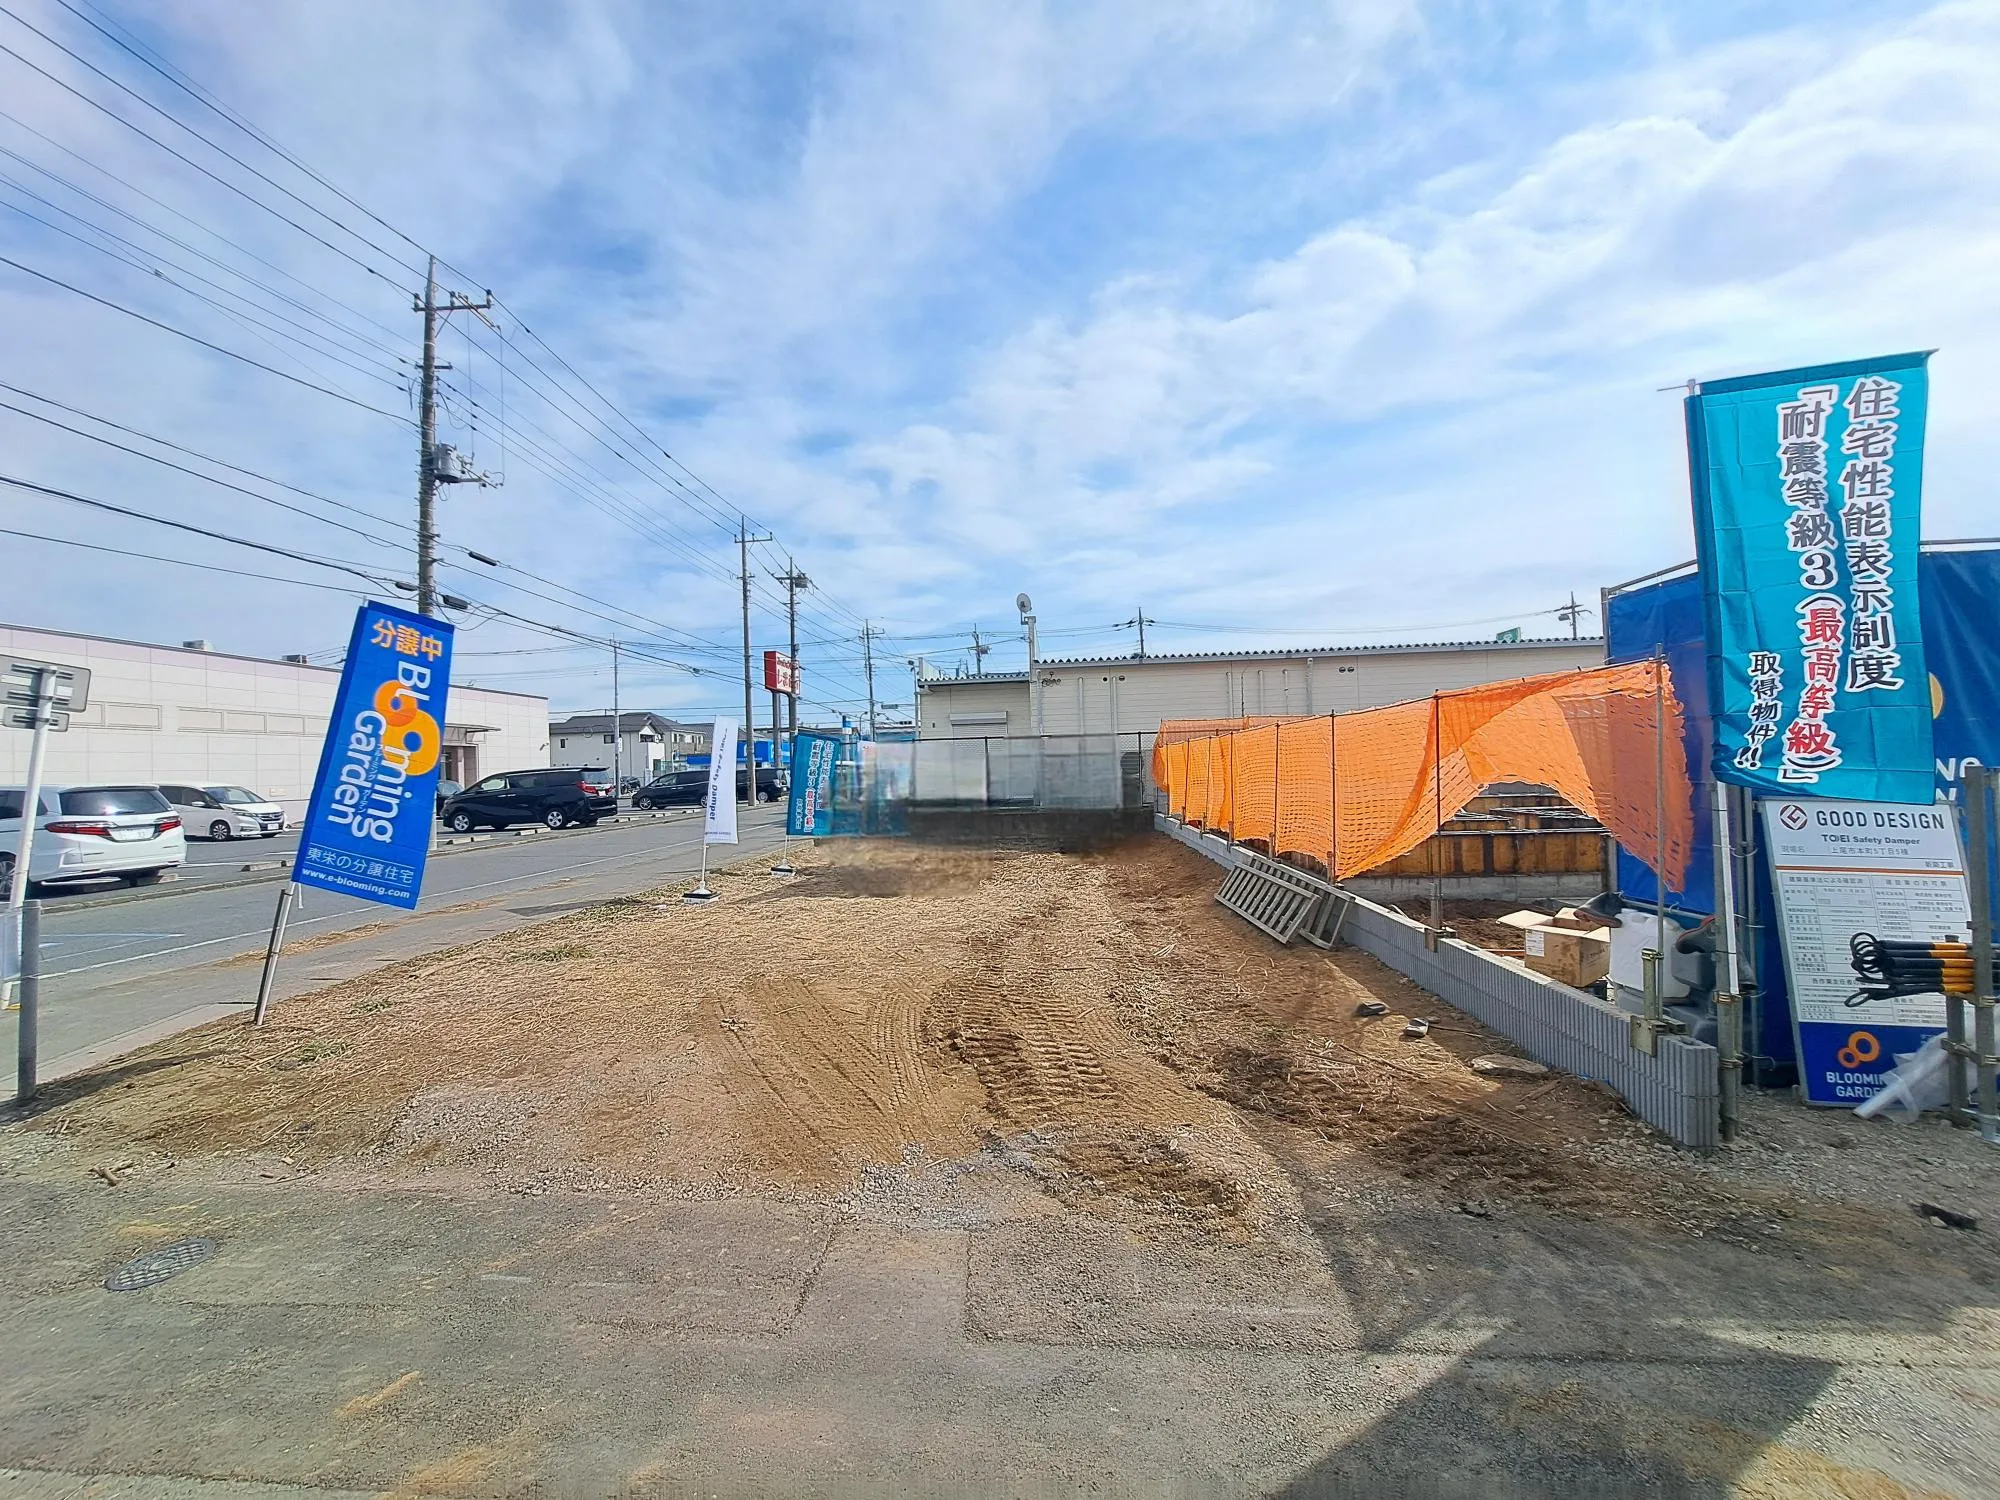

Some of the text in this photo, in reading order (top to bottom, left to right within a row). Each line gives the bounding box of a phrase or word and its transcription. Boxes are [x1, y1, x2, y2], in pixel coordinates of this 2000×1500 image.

[1844, 378, 1899, 690] 住宅性能表示制度
[371, 617, 443, 663] 分譲中
[328, 710, 388, 826] Garden
[1816, 810, 1945, 830] GOOD DESIGN
[1852, 835, 1882, 846] Safety
[1884, 836, 1920, 845] Damper
[302, 867, 410, 899] www.e-blooming.com
[305, 846, 415, 885] 東栄の分譲住宅
